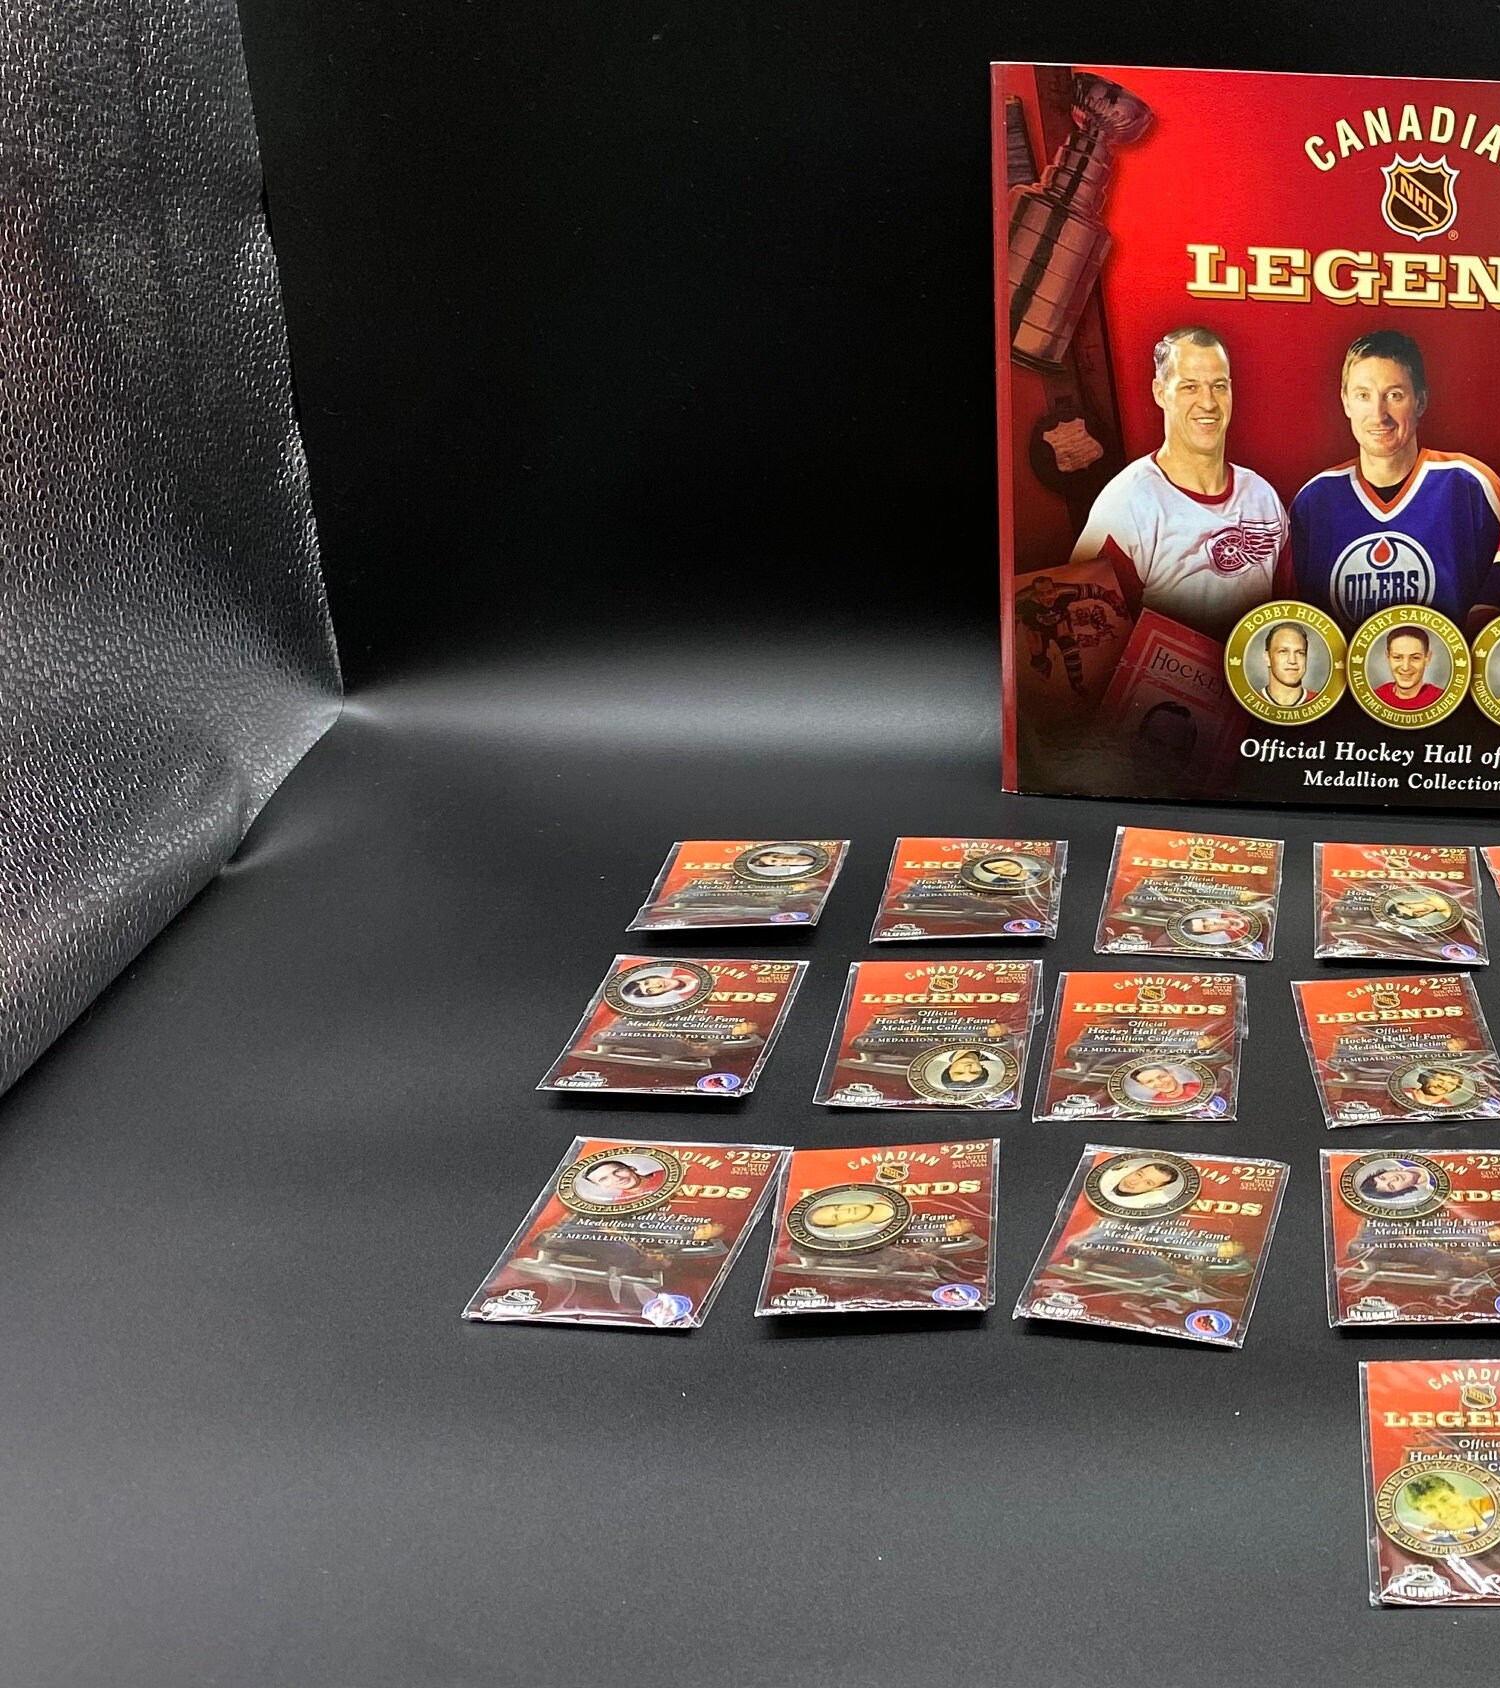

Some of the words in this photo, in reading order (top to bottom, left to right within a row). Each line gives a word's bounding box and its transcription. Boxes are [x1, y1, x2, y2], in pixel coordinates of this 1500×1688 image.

[1400, 176, 1439, 221] NHL
[1344, 570, 1419, 607] OILERS
[1244, 605, 1291, 633] BOBBY
[1296, 607, 1331, 635] HULL
[1356, 613, 1393, 650] TERRY
[1400, 610, 1465, 654] SAWCHUK
[1243, 692, 1254, 704] 12
[1302, 695, 1332, 718] GAMES
[1380, 709, 1424, 723] SHUTOUT
[1427, 693, 1458, 720] LEADER
[1455, 674, 1465, 688] 103
[1240, 738, 1326, 762] Official
[1334, 742, 1415, 766] Hockey
[1424, 744, 1472, 764] Hall
[1303, 770, 1400, 788] Medallion
[1168, 838, 1238, 854] CANADIAN
[1363, 849, 1432, 862] CANADIAN
[1131, 857, 1269, 874] LEGENDS
[1331, 869, 1465, 880] LEGENDS
[904, 965, 986, 981] CANADIAN
[1114, 976, 1193, 992] CANADIAN
[1347, 982, 1422, 999] CANADIAN
[861, 992, 1020, 1004] LEGENDS
[1073, 1002, 1226, 1015] LEGENDS
[1316, 1006, 1465, 1024] LEGENDS
[875, 1017, 918, 1025] Hockey
[1128, 1020, 1167, 1028] Official
[1088, 1027, 1129, 1036] Hockey
[1375, 1027, 1412, 1035] Official
[1340, 1037, 1379, 1045] Hockey
[847, 1150, 940, 1170] CANADIAN
[576, 1218, 638, 1228] Medallion
[639, 1221, 698, 1232] Collection
[676, 1215, 712, 1224] Fame
[921, 1213, 956, 1222] Fame
[1415, 1218, 1442, 1227] Hall
[1446, 1218, 1458, 1229] of
[1463, 1218, 1495, 1226] Fame
[1098, 1219, 1145, 1233] Hockey
[1149, 1224, 1178, 1236] Hall
[1197, 1229, 1231, 1241] Fame
[1374, 1227, 1429, 1235] Medallion
[1433, 1227, 1489, 1235] Collection
[658, 1238, 707, 1247] COLLECT
[1103, 1230, 1162, 1243] Medallion
[1164, 1236, 1220, 1249] Collection
[1410, 1451, 1462, 1462] Hockey
[1466, 1451, 1498, 1461] Hall
[1378, 1476, 1402, 1521] WAYNE
[1400, 1460, 1476, 1478] GRETZKY
